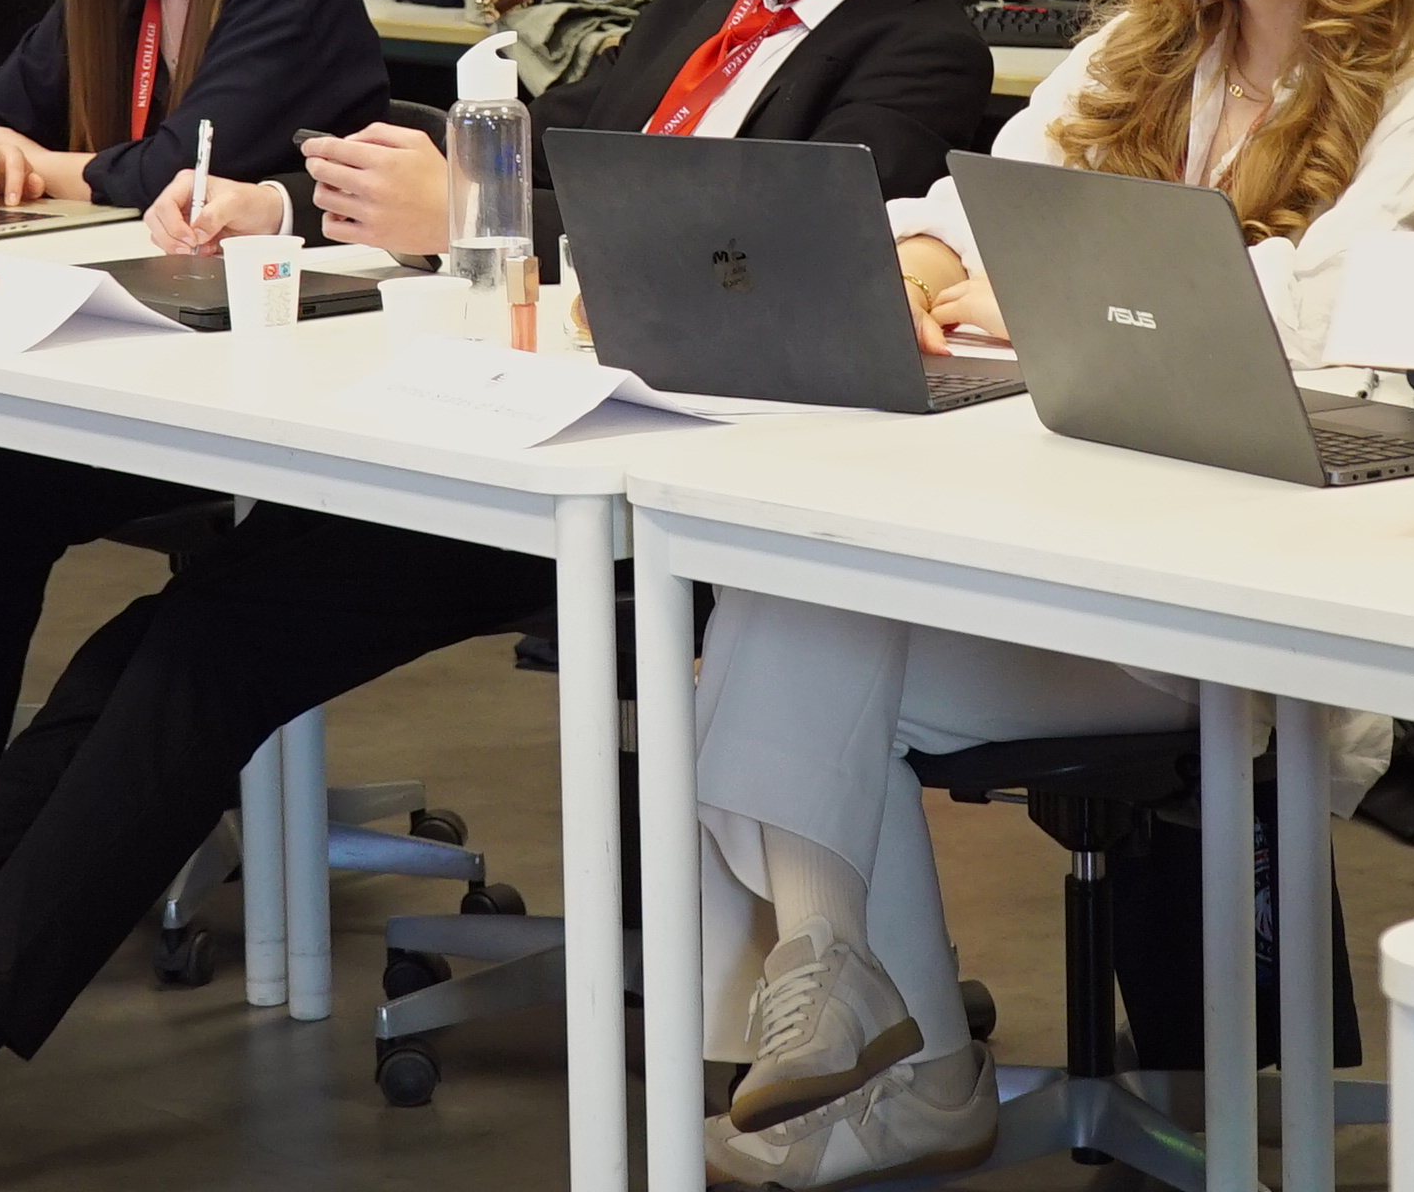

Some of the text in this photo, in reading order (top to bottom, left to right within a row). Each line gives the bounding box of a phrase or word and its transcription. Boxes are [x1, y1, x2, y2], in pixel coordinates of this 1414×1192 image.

[137, 22, 158, 108] KING'S COLLEGE
[1107, 306, 1157, 329] ASUS
